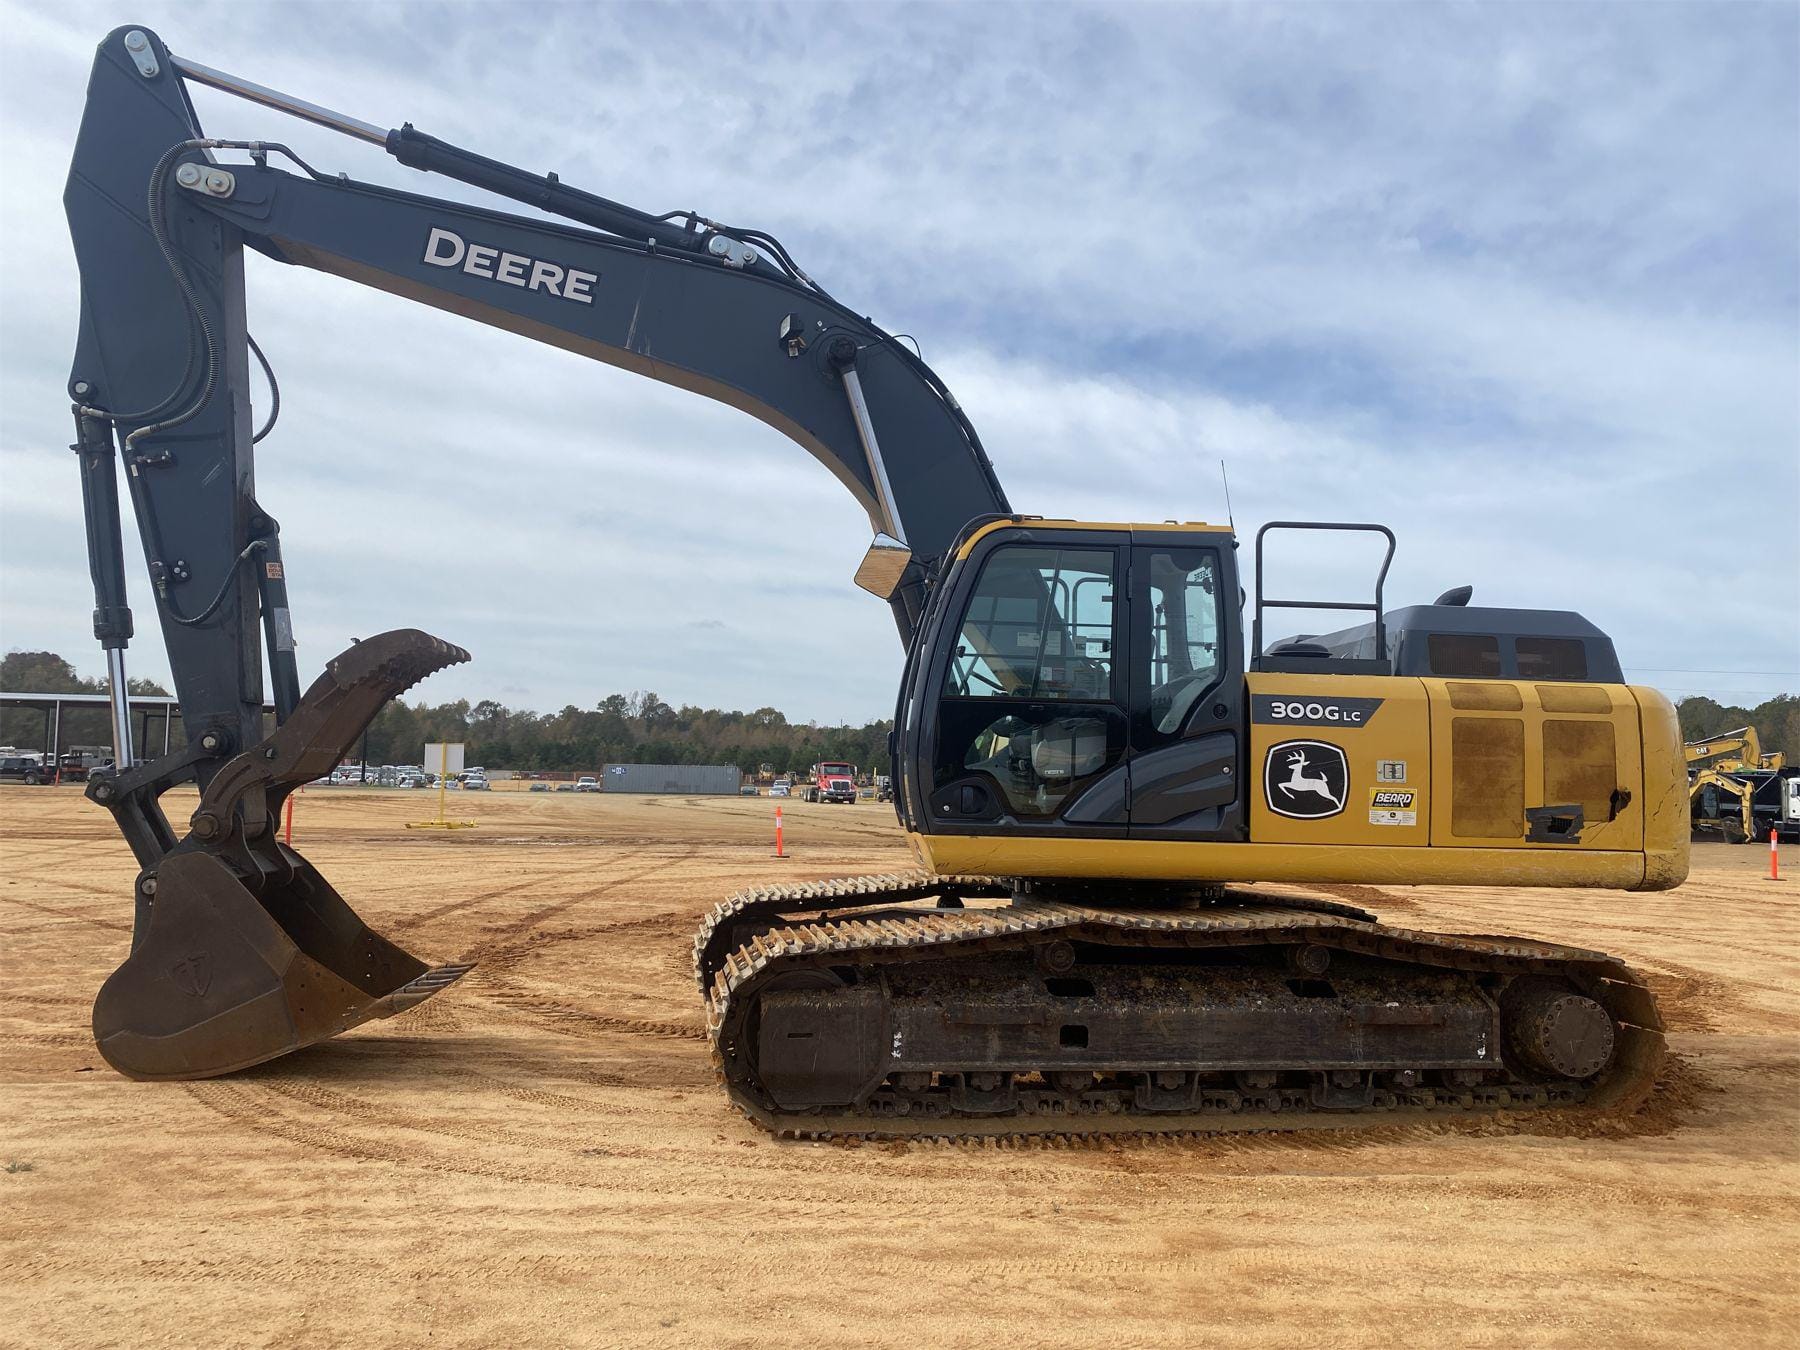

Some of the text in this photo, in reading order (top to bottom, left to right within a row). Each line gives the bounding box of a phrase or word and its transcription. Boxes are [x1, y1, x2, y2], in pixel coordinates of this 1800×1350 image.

[424, 228, 597, 304] DEERE
[1271, 702, 1361, 722] 300G LC
[1696, 747, 1708, 755] CAT
[1375, 793, 1412, 807] BEARD
